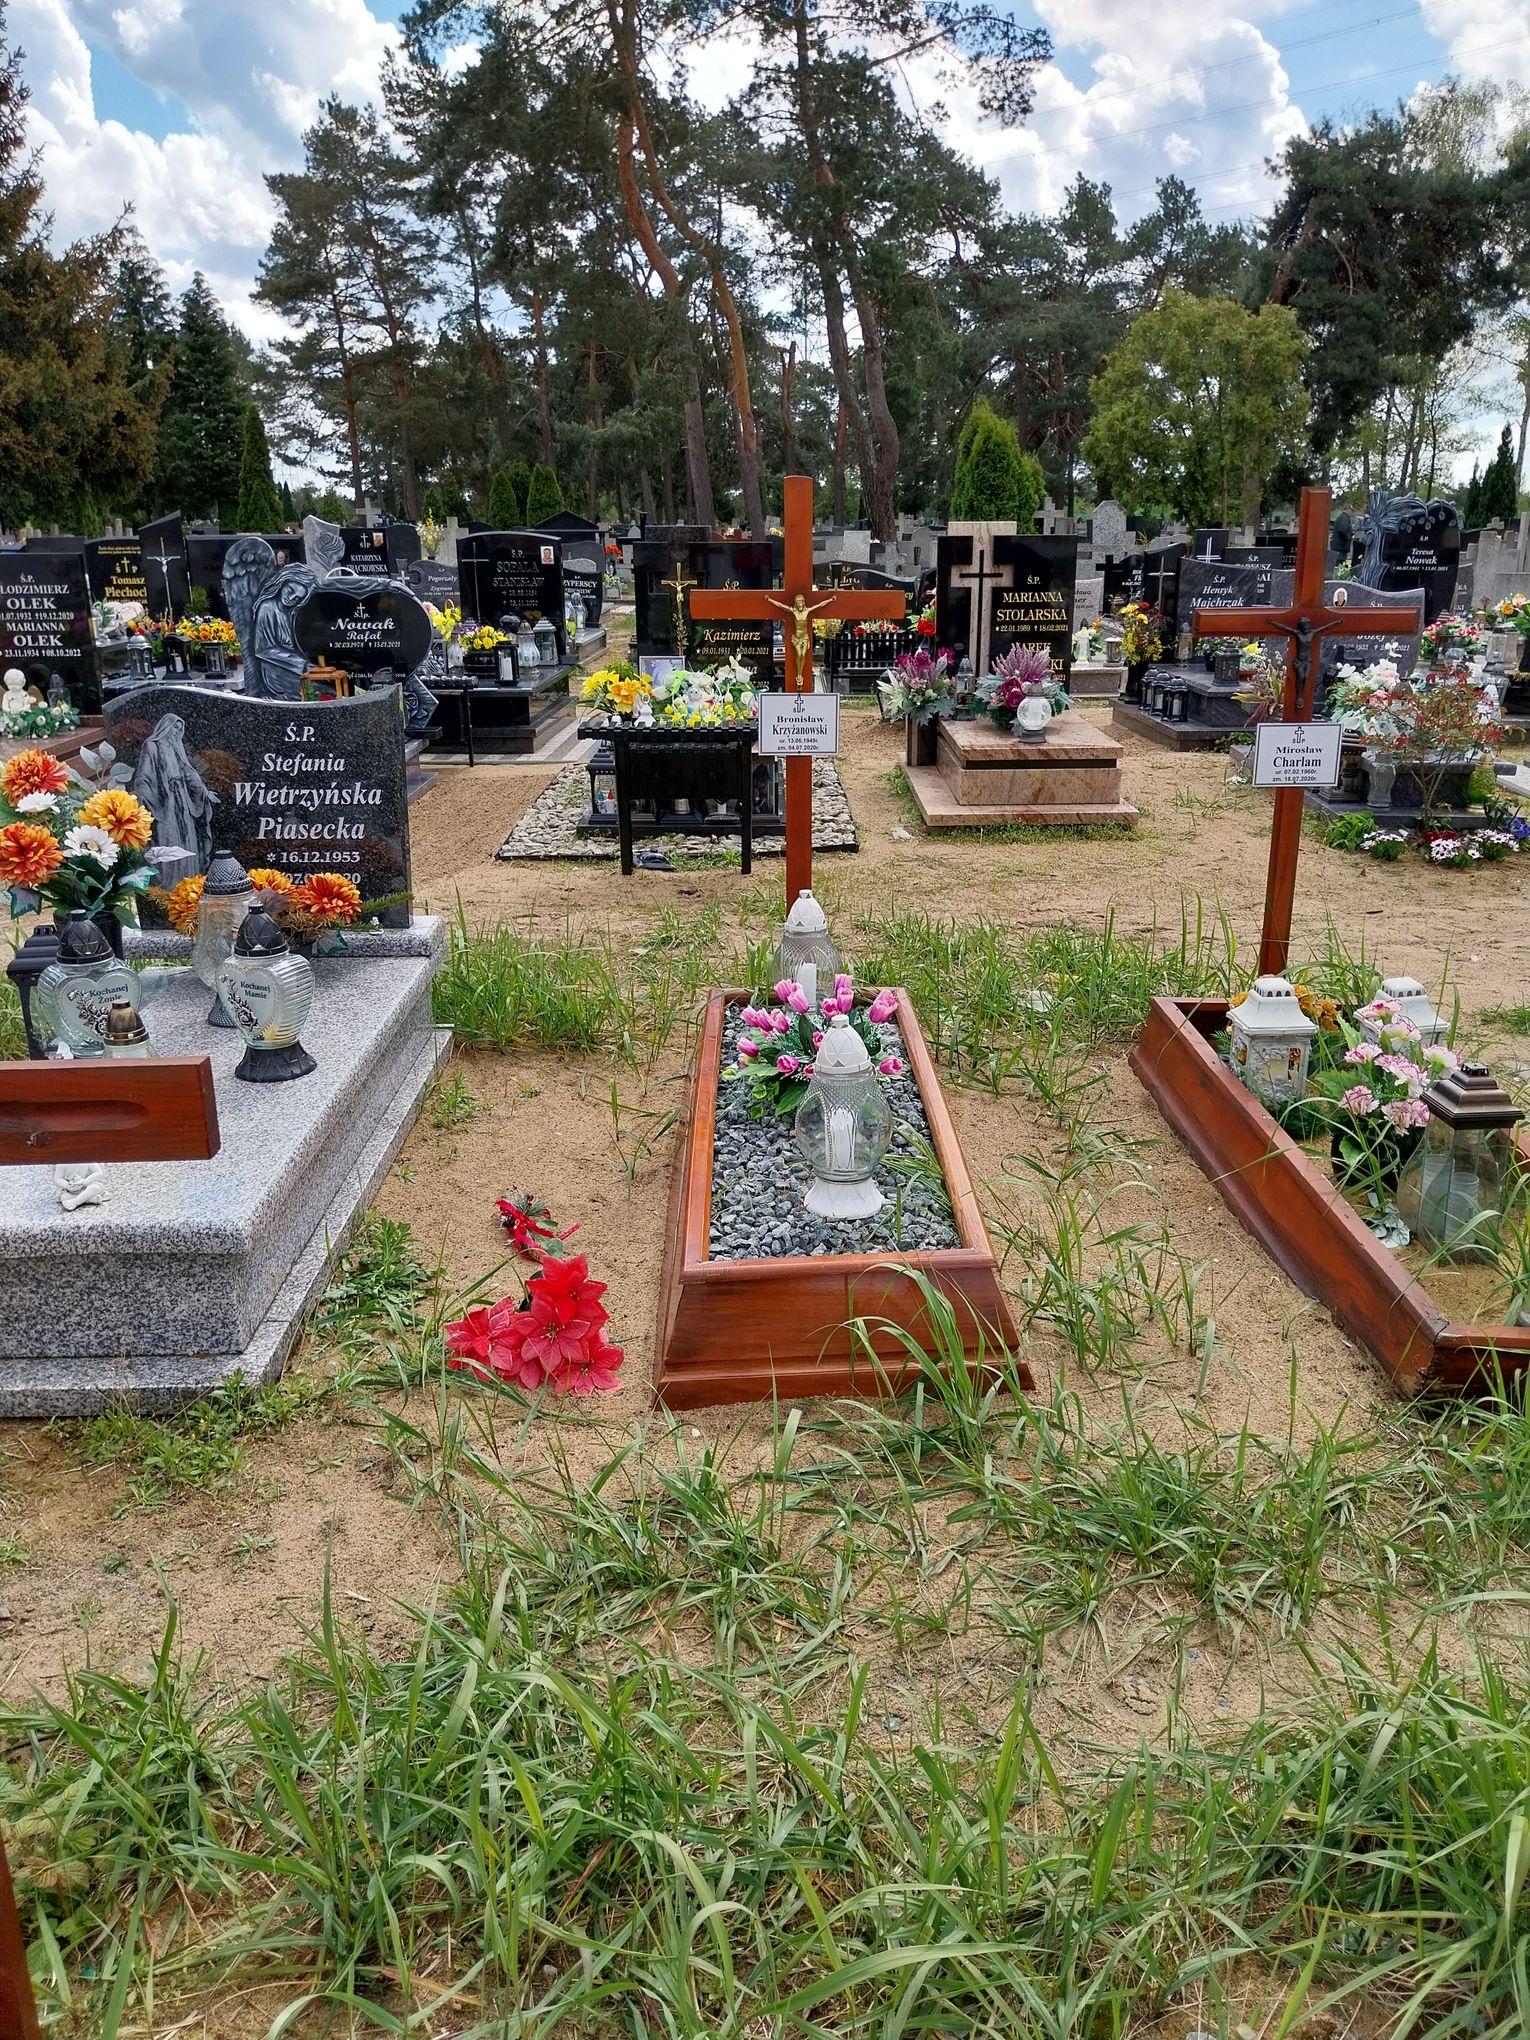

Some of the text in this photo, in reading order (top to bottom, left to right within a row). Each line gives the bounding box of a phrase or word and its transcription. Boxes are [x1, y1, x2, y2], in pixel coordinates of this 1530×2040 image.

[1411, 548, 1434, 556] Teresa
[1405, 555, 1438, 565] Nowak
[110, 576, 146, 585] Tomasz
[1003, 591, 1064, 603] MARIANNA
[1202, 585, 1235, 596] Henryk
[6, 597, 57, 610] OLEK
[1189, 596, 1245, 609] Majchrzak
[996, 608, 1068, 622] STOLARSKA
[6, 622, 66, 632] MARIANNA
[330, 618, 396, 630] Nowak
[13, 634, 64, 647] OLEK
[703, 628, 761, 643] Kazimierz
[285, 722, 315, 742] Ś.P.
[772, 724, 828, 738] Krzyżanowski
[261, 753, 346, 777] Stefania
[233, 781, 383, 812] Wietrzyńska
[256, 817, 367, 840] Piasecka
[280, 851, 361, 863] 16.12.1953
[89, 983, 129, 998] Kochanej
[240, 981, 271, 994] Kochanej
